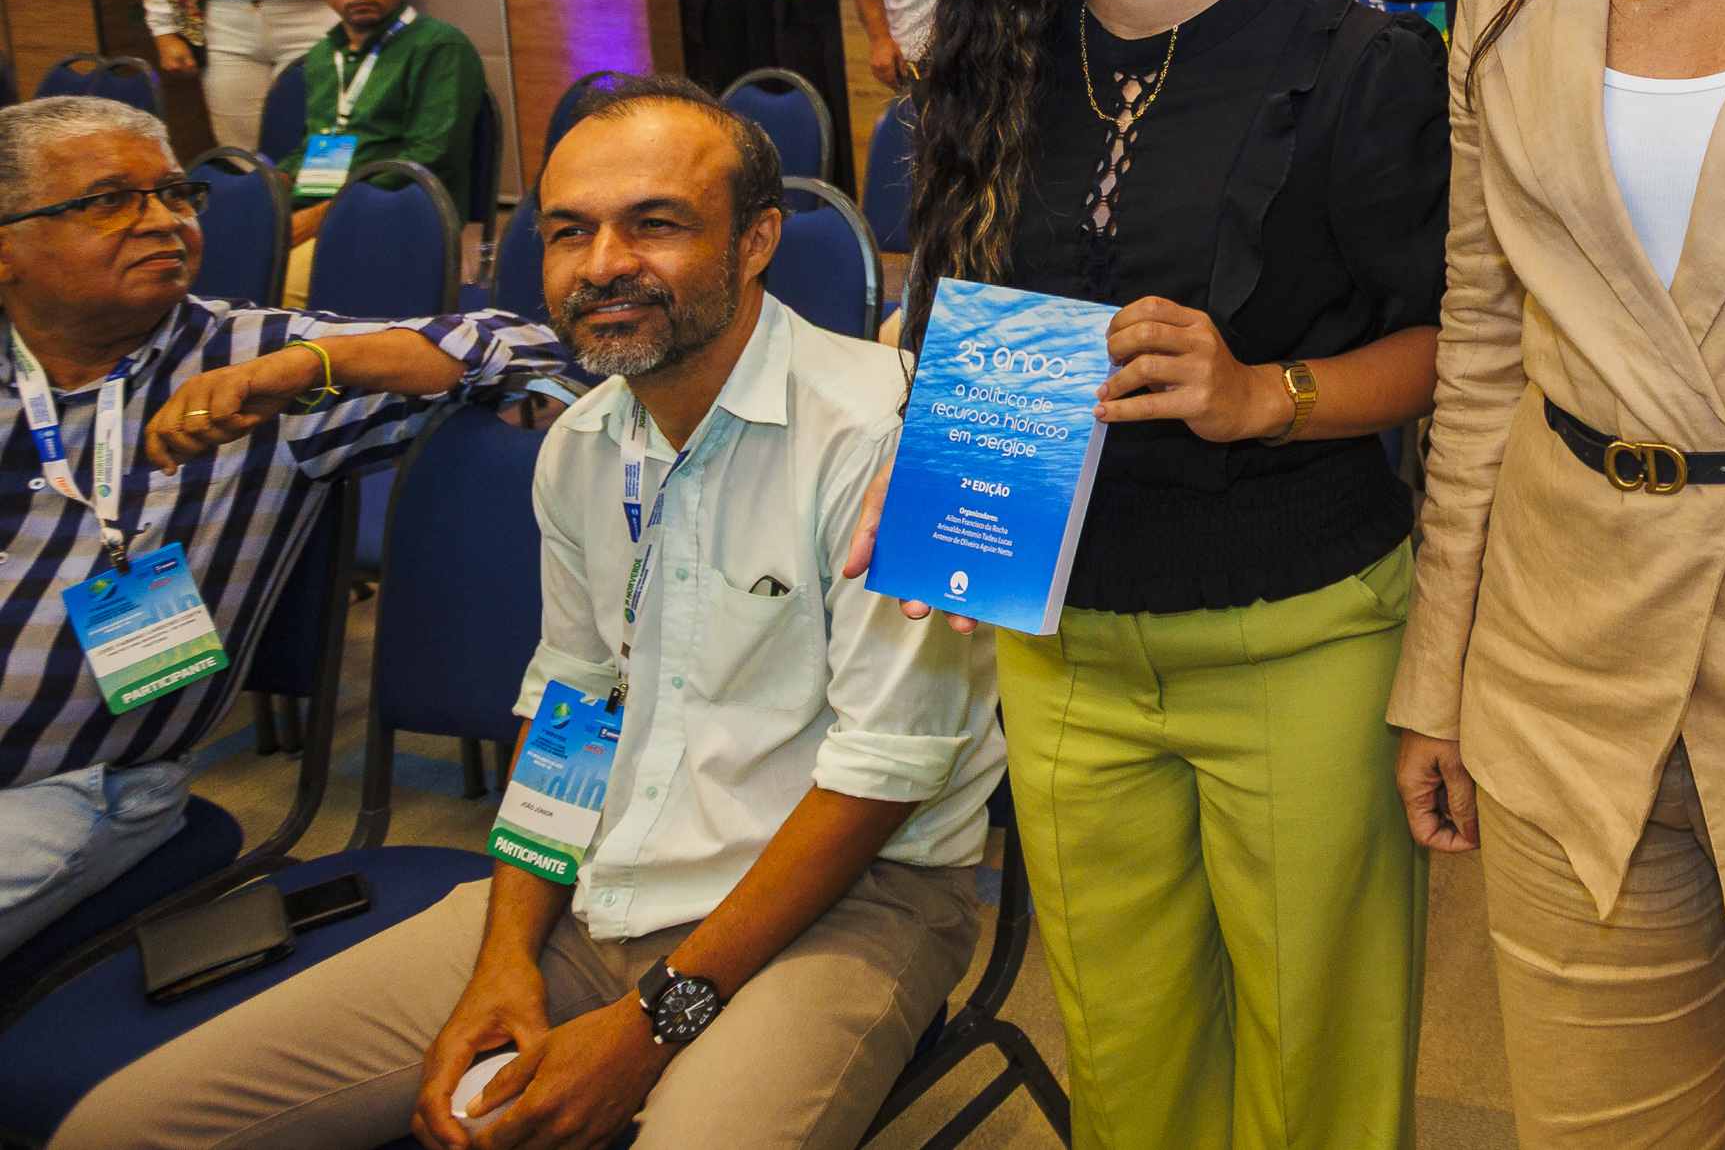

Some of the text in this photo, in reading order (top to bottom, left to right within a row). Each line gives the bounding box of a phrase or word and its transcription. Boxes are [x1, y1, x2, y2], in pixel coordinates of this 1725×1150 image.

[955, 340, 987, 371] 25
[955, 384, 1054, 413] a política de
[931, 402, 1068, 440] recursos hídricos
[949, 428, 1037, 458] em sergipe
[972, 479, 1011, 498] EDIÇÃO
[626, 558, 643, 599] NORVERDE
[121, 656, 218, 704] PARTICIPANTE
[494, 836, 568, 875] PARTICIPANTE
